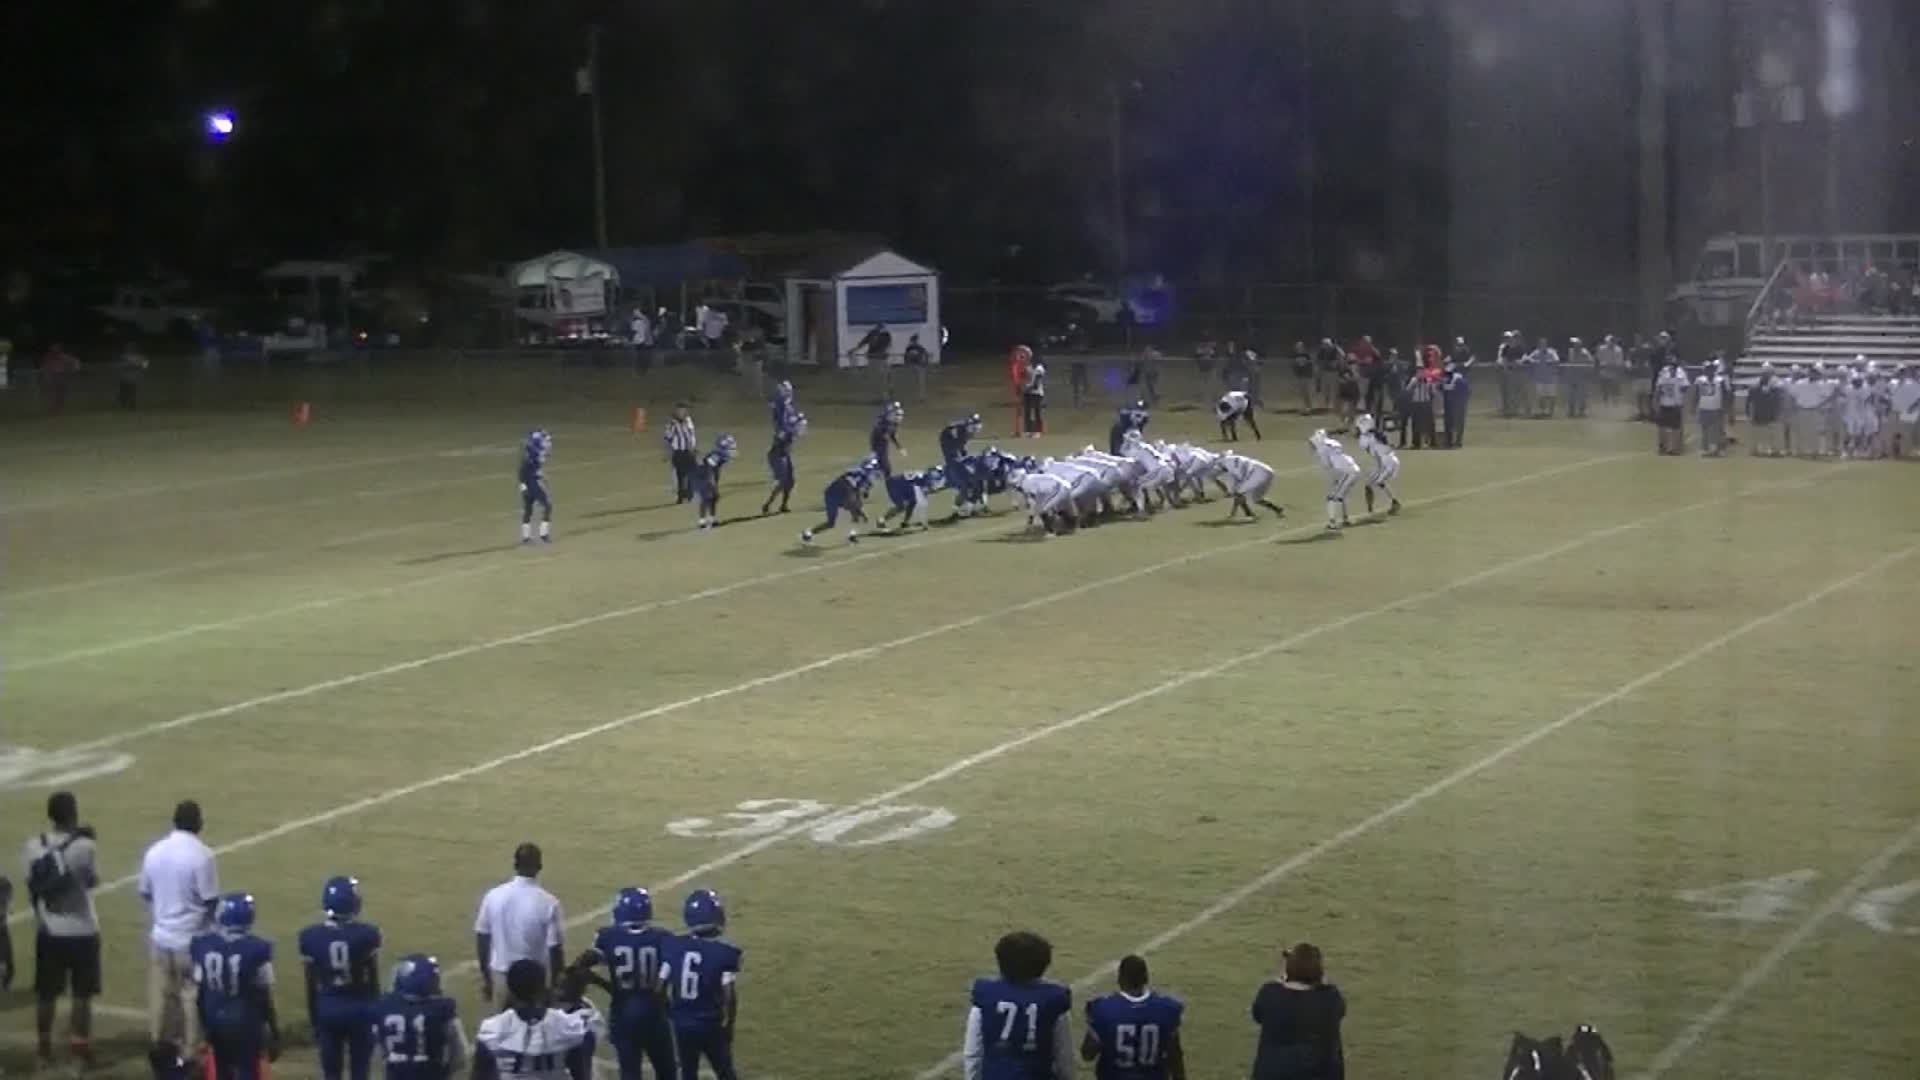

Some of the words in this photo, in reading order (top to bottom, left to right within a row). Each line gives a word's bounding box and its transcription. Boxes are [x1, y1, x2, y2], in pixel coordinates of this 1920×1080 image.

[665, 798, 958, 845] 30
[204, 951, 242, 996] 81
[329, 941, 350, 986] 9
[613, 946, 658, 989] 20
[681, 951, 703, 1000] 6
[383, 1014, 429, 1062] 21
[996, 1001, 1038, 1050] 71
[1115, 1023, 1160, 1068] 50
